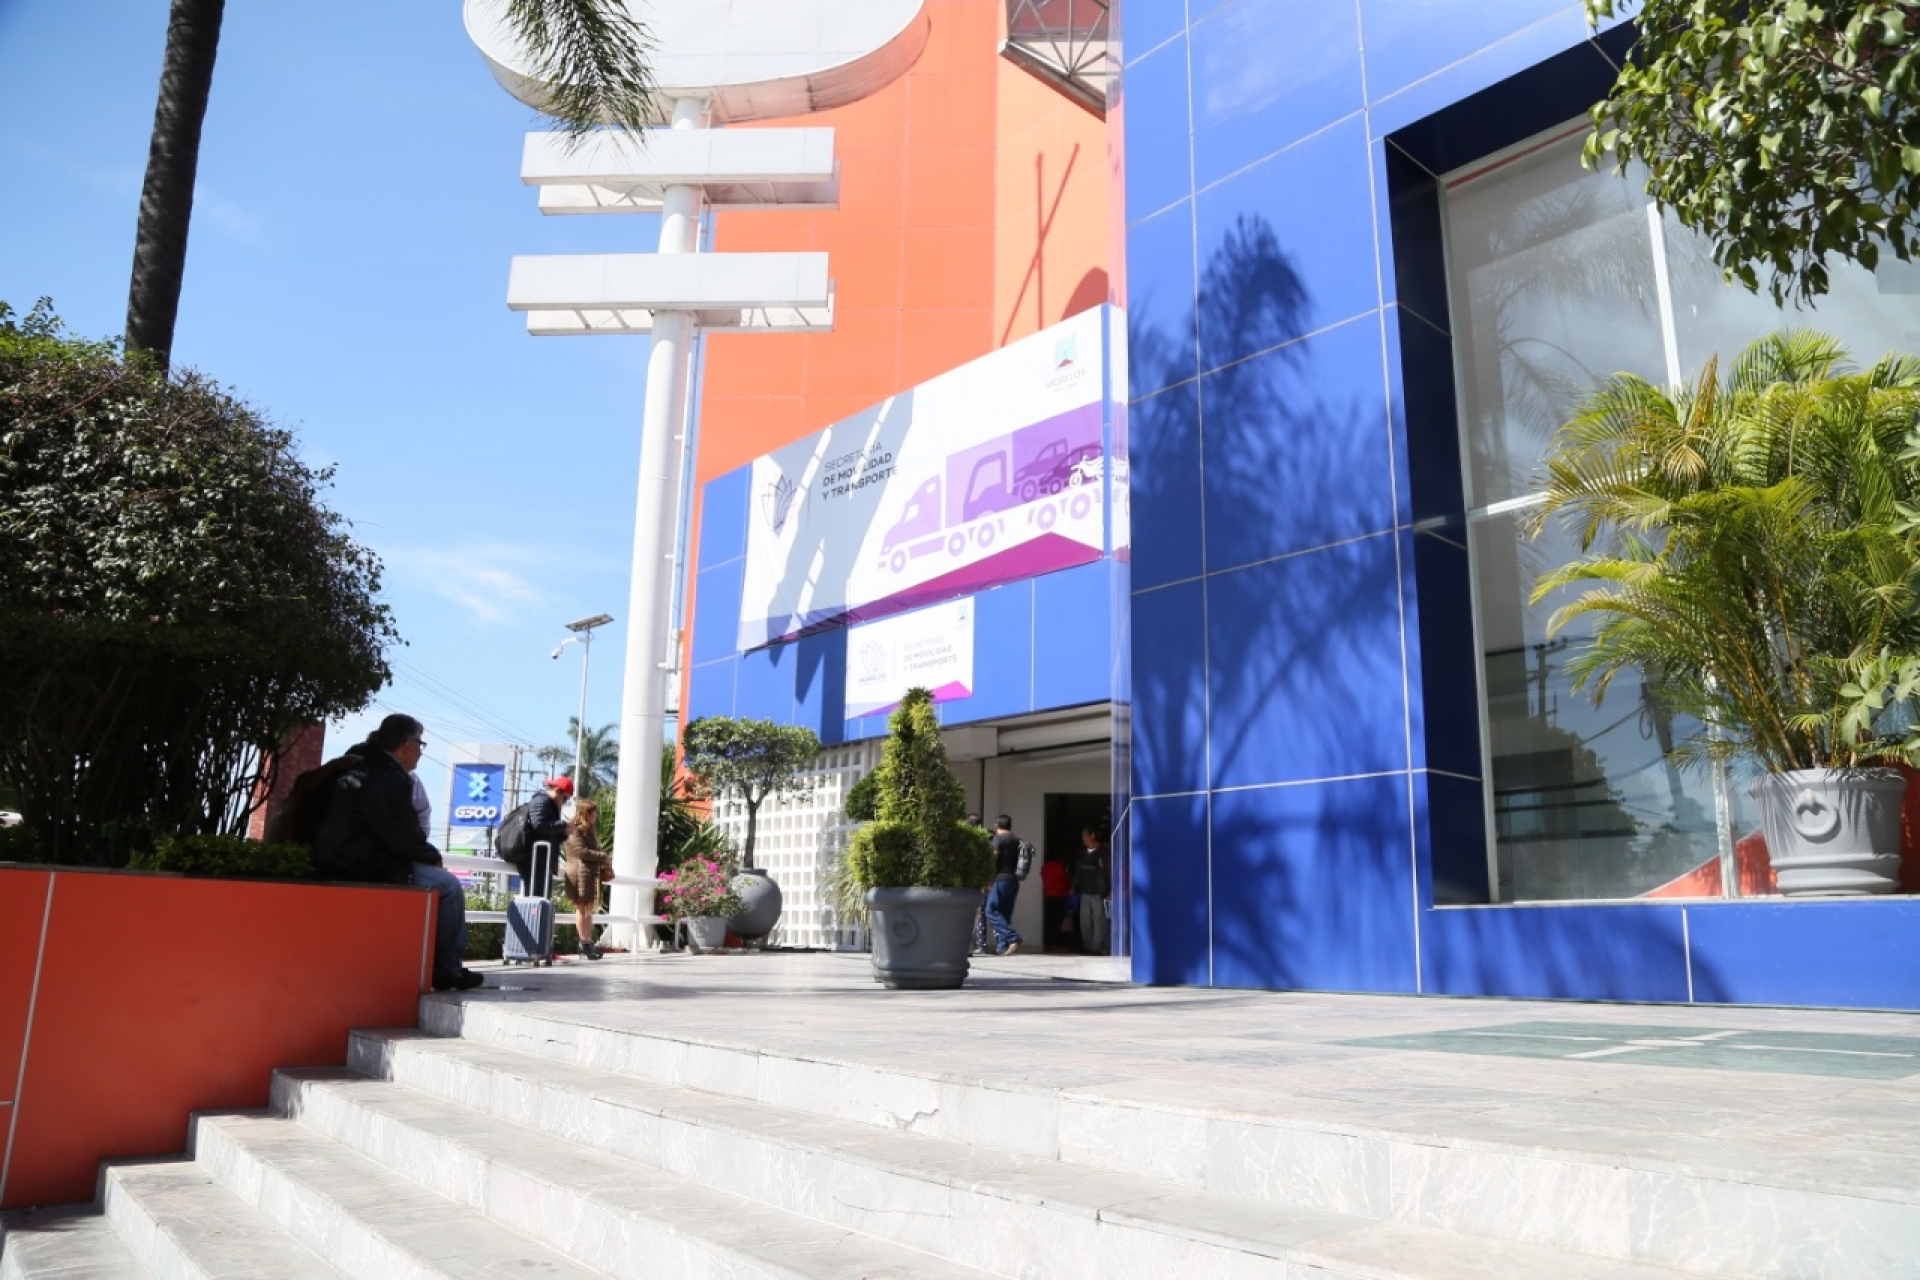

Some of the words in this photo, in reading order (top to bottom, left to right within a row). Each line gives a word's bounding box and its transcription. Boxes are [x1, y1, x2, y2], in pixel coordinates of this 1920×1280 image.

[822, 490, 829, 501] Y
[830, 465, 897, 498] TRANSPORTE
[823, 474, 836, 487] DE
[838, 452, 892, 481] MOVLIDAD
[455, 806, 497, 819] G500
